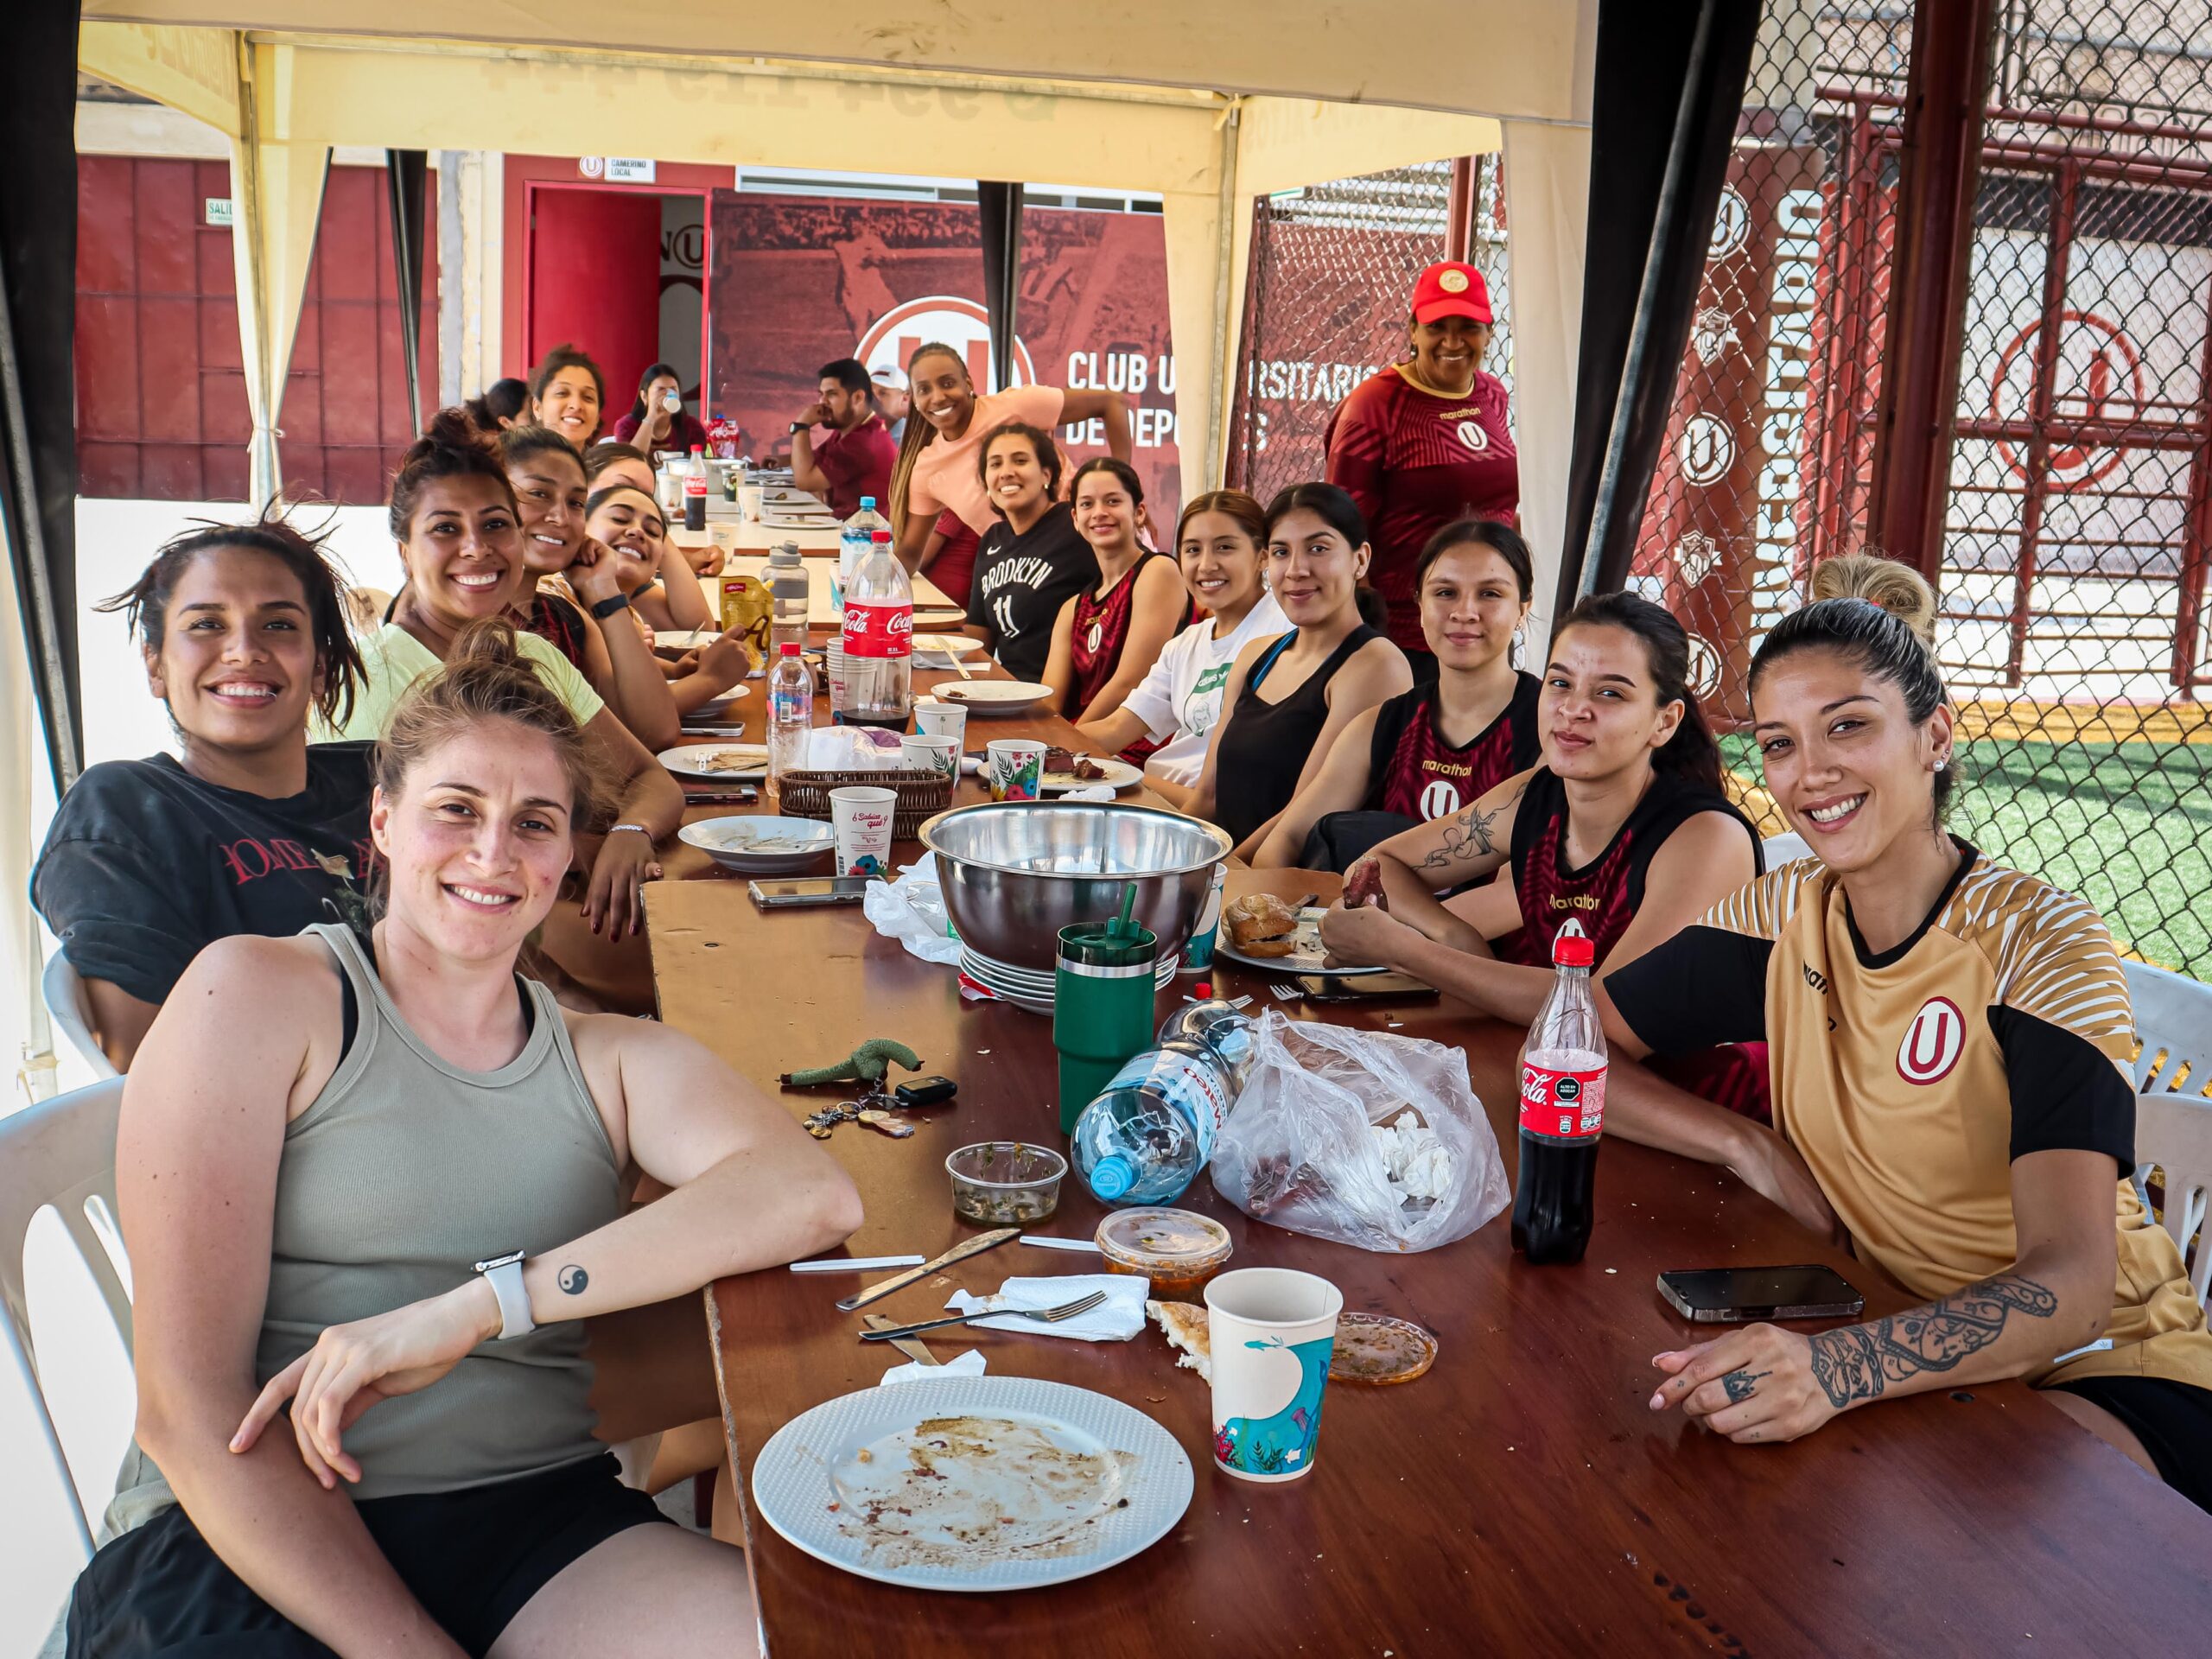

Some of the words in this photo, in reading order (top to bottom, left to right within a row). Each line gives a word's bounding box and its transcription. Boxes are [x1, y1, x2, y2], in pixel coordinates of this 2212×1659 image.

[611, 158, 646, 168] CAMERINO
[1068, 351, 1148, 393] CLUB
[1440, 407, 1481, 420] marathon
[1461, 425, 1483, 448] U
[982, 556, 1053, 598] BROOKLYN
[993, 594, 1020, 639] 11
[1908, 1012, 1948, 1074] U
[1183, 1067, 1222, 1130] Mateo
